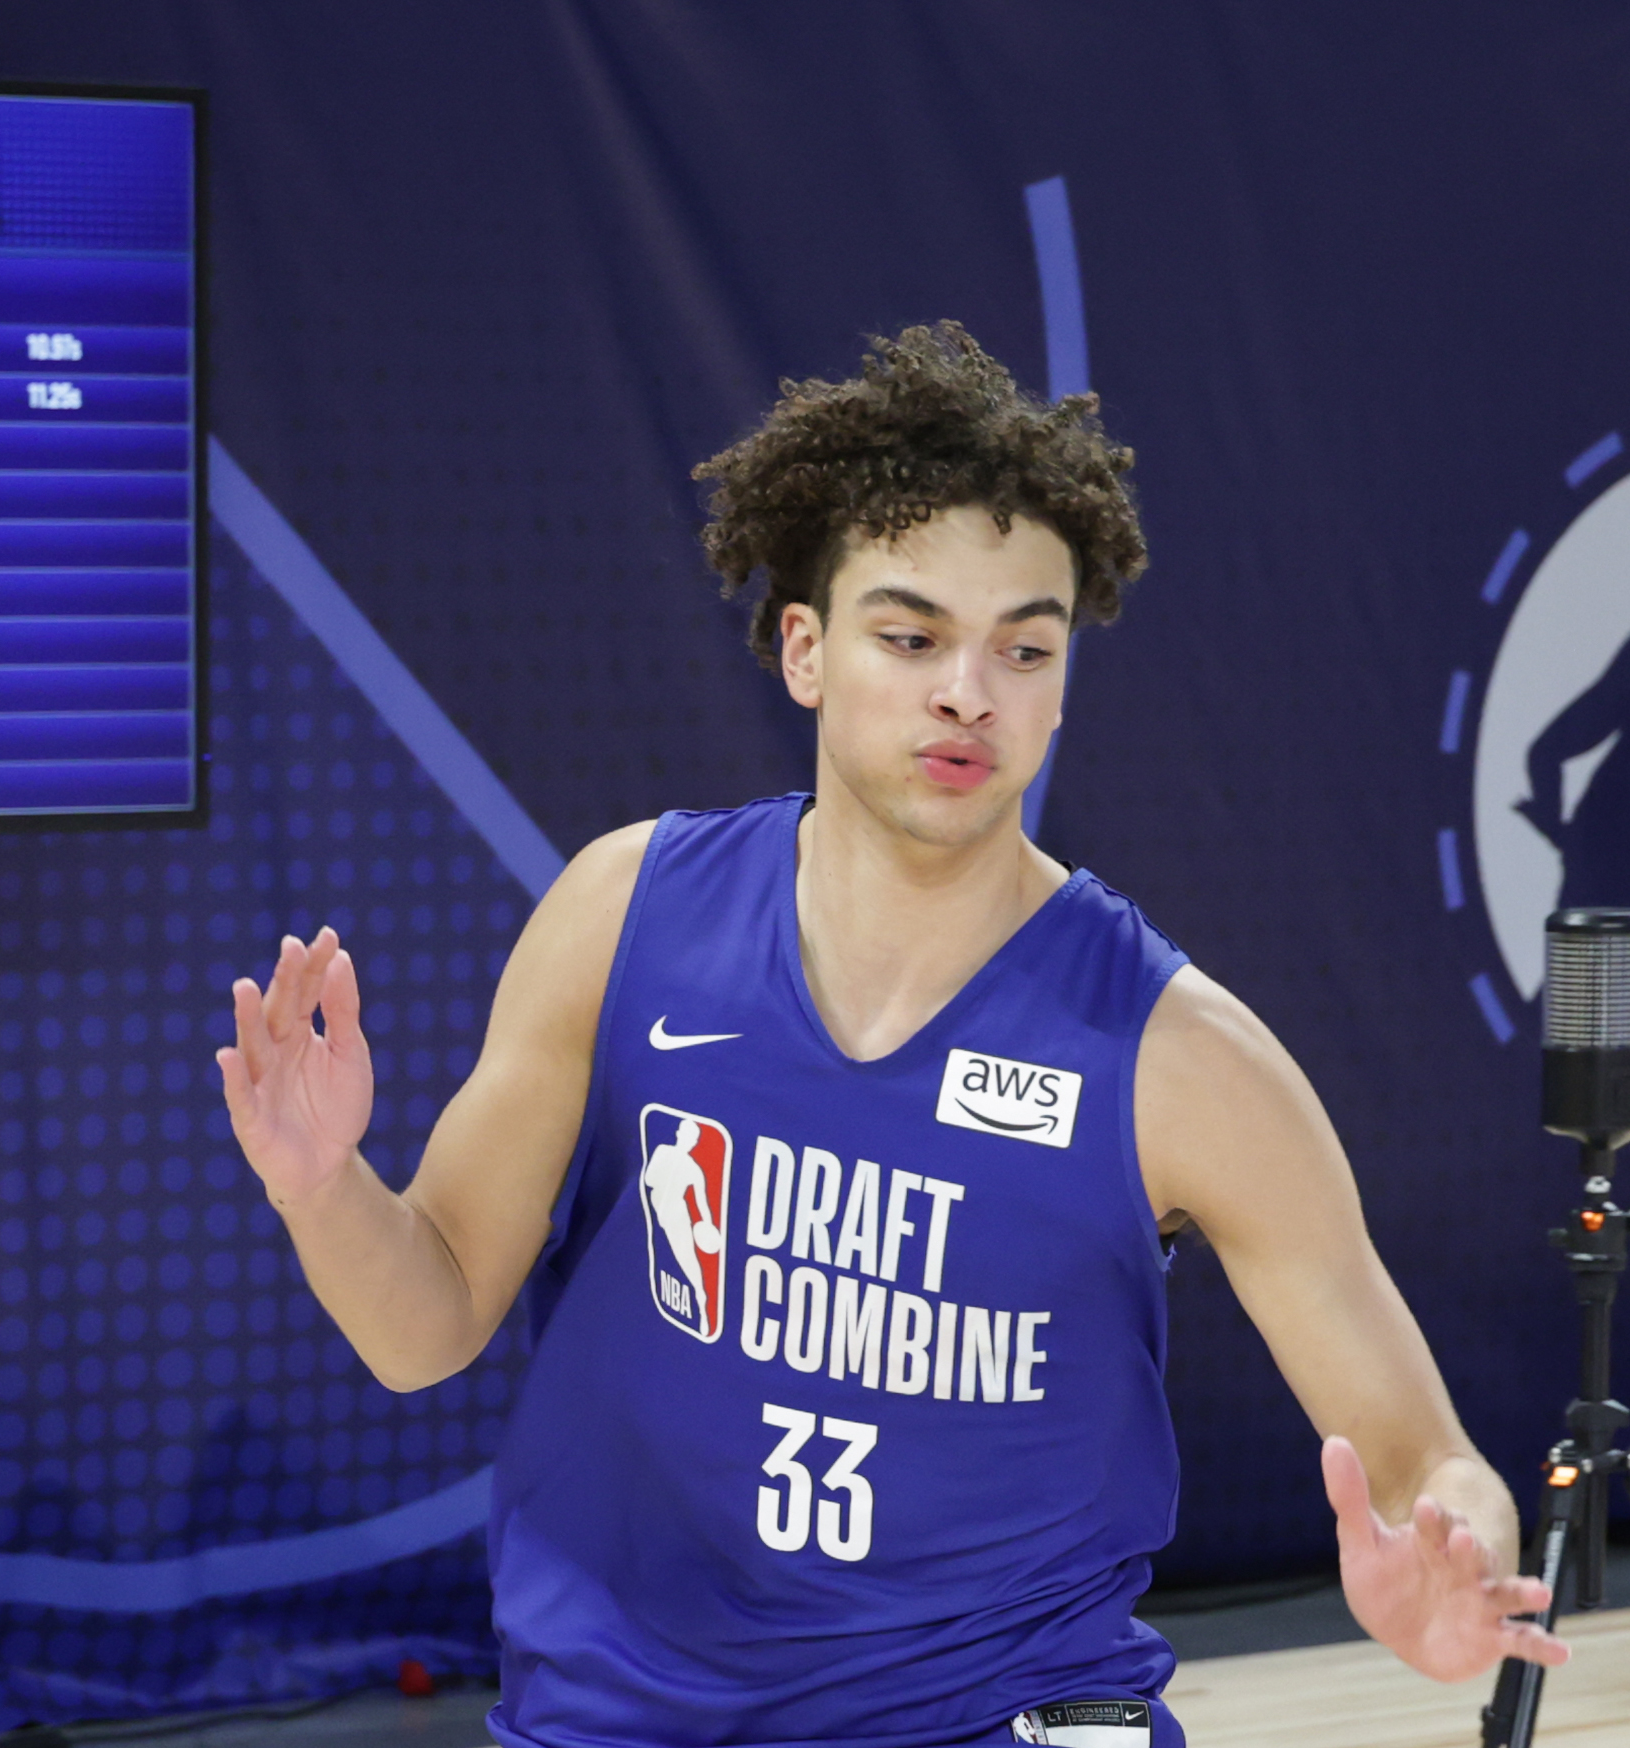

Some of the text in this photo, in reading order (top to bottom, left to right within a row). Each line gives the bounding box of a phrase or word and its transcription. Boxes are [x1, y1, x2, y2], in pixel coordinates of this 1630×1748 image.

[962, 1058, 1061, 1107] aws
[746, 1135, 966, 1294] DRAFT
[659, 1269, 693, 1320] NBA
[739, 1253, 1052, 1404] COMBINE
[756, 1401, 879, 1563] 33
